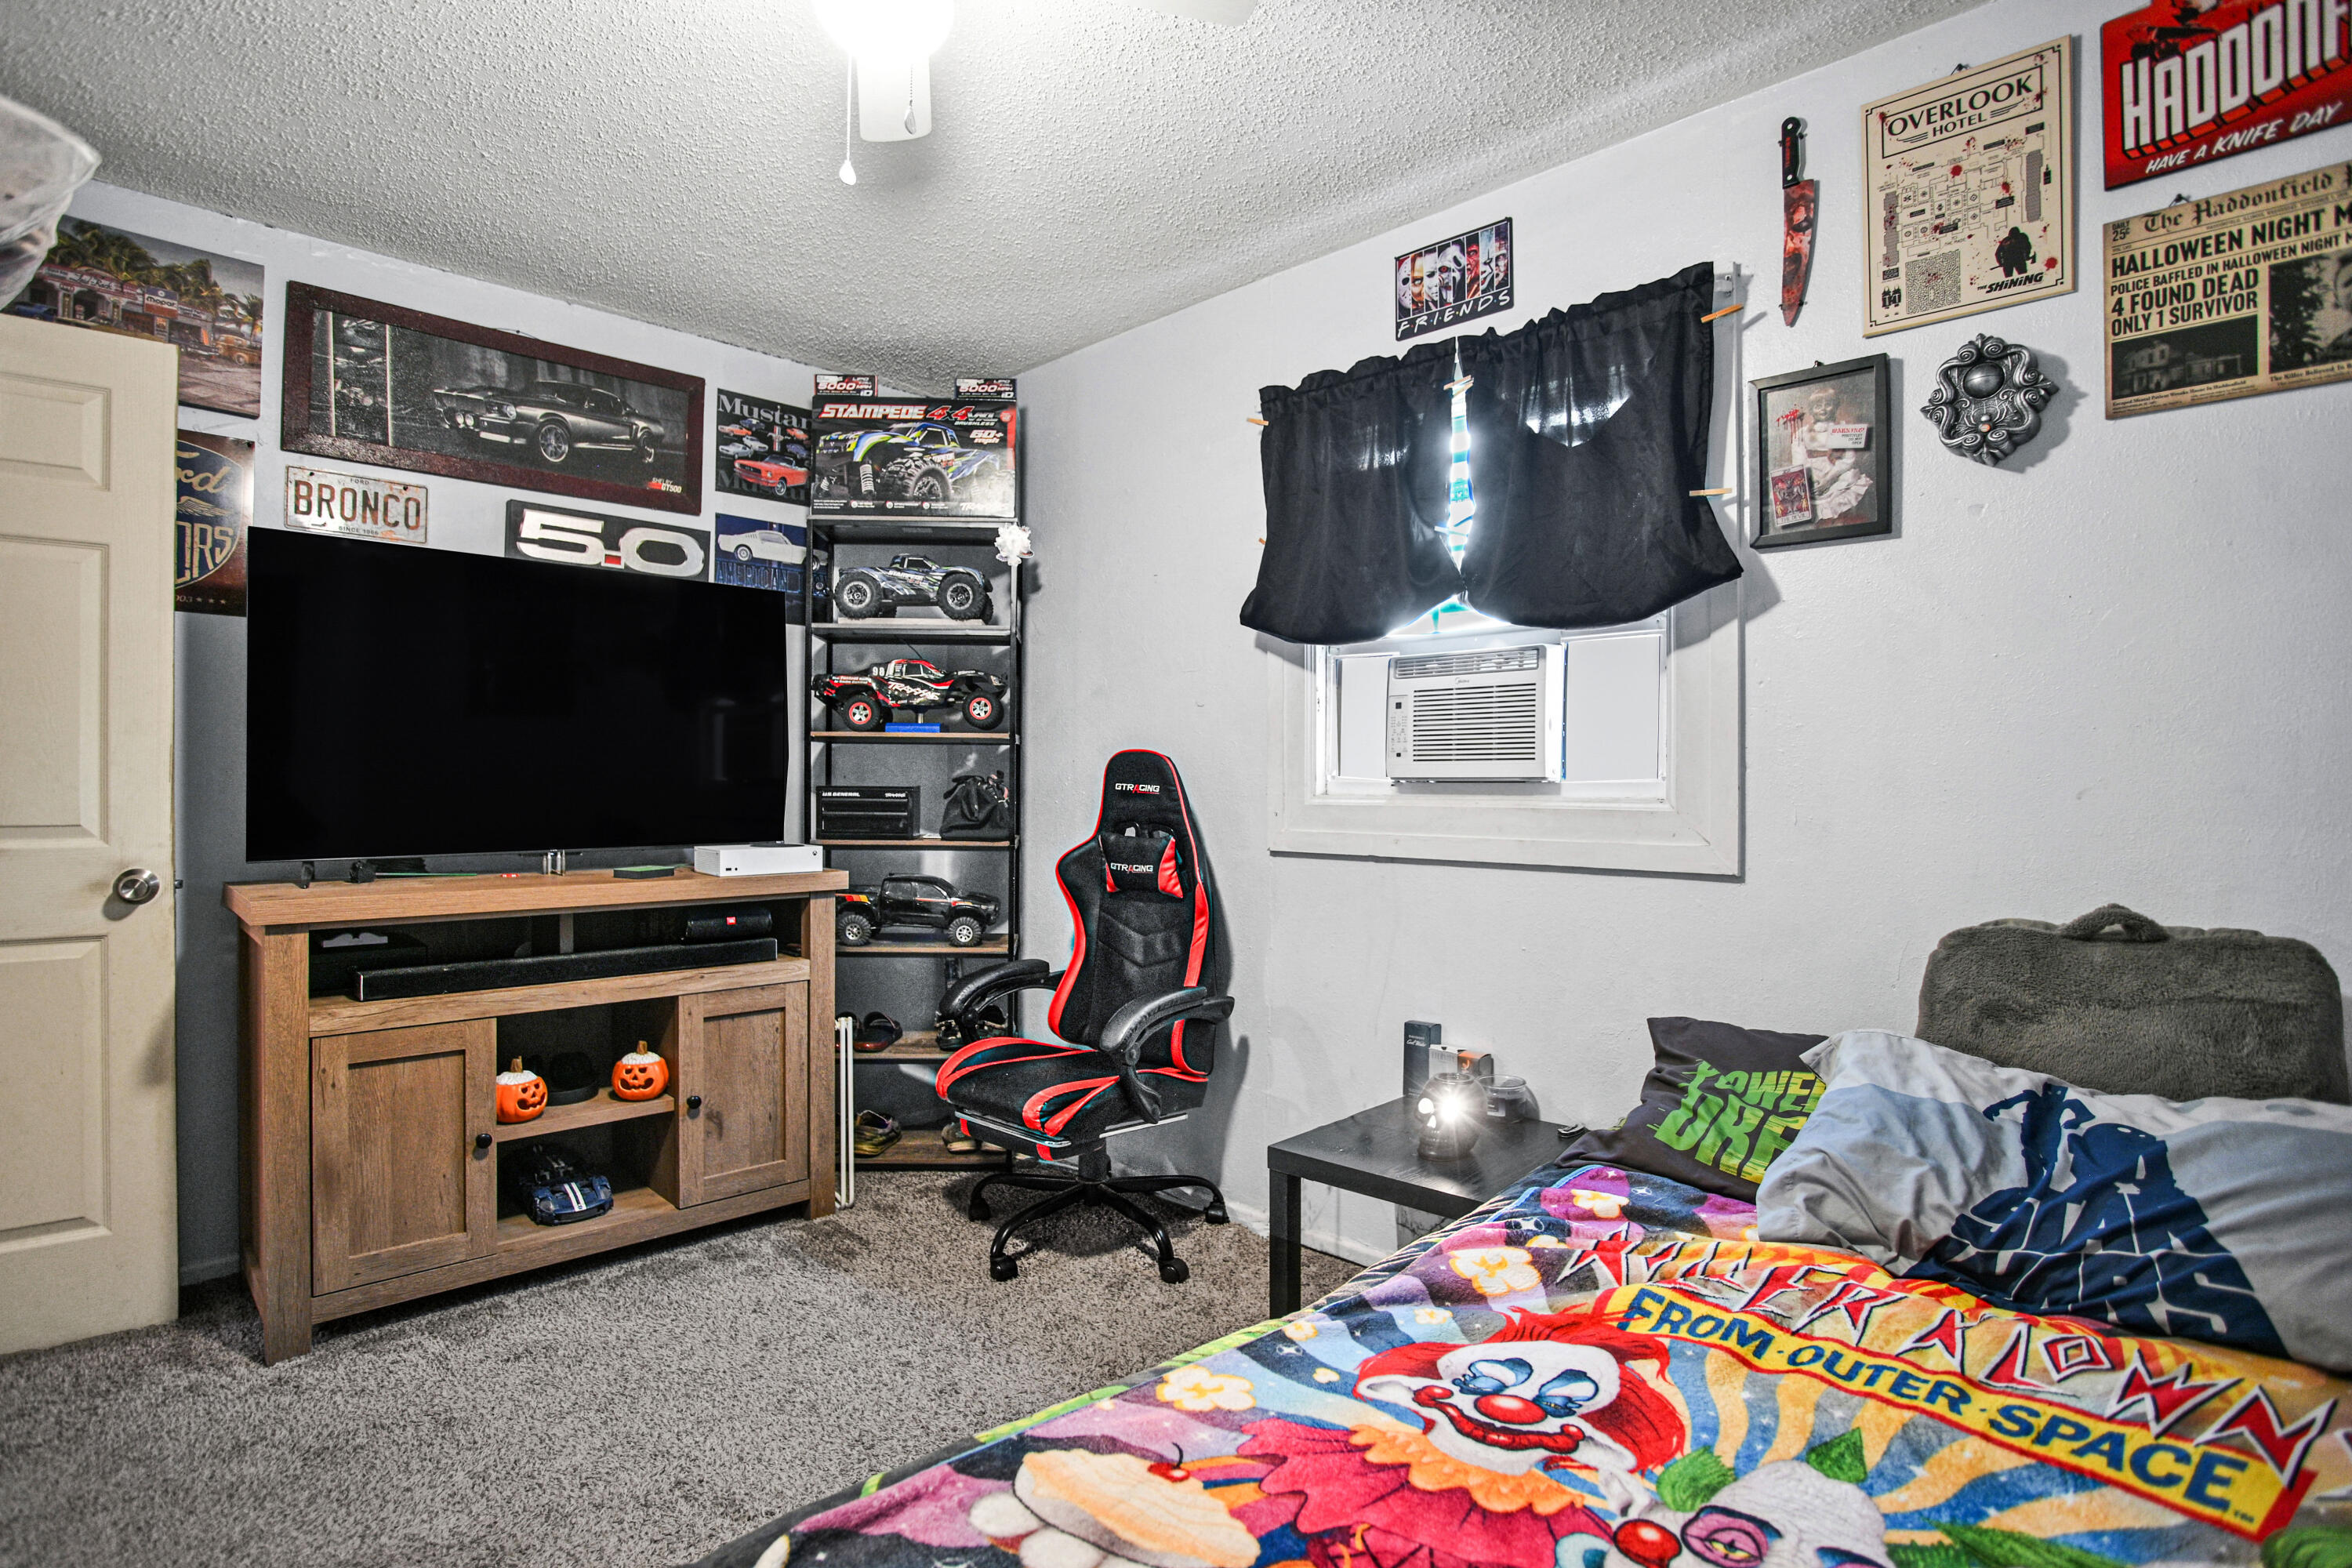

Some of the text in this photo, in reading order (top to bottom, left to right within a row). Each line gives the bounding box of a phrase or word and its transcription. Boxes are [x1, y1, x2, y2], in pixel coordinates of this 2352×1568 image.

[1888, 74, 2032, 136] OVERLOOK
[1933, 111, 1987, 137] HOTEL
[2146, 101, 2343, 174] HAVE A KNIFE DAY
[2112, 220, 2130, 230] DAILY
[2144, 212, 2183, 233] The
[2192, 172, 2332, 226] Haddonfield
[2111, 228, 2243, 278] HALLOWEEN
[2252, 209, 2325, 246] NIGHT
[2111, 277, 2150, 296] POLICE
[2153, 266, 2202, 287] BAFFLED
[2206, 262, 2219, 274] IN
[2223, 243, 2297, 272] HALLOWEEN
[2301, 234, 2341, 254] NIGHT
[2111, 268, 2259, 317] 4 FOUND DEAD
[2111, 291, 2258, 337] ONLY 1 SURVIVOR
[818, 404, 929, 419] STAMPEDE
[969, 429, 1004, 439] 60+
[652, 477, 673, 485] SHELBY
[660, 483, 683, 494] GT500
[294, 480, 421, 530] BRONCO
[516, 509, 706, 577] 5.0
[872, 666, 885, 677] 98
[1115, 783, 1160, 794] GTRACING
[1110, 863, 1154, 873] GTRACING
[1617, 1287, 2249, 1512] FROM OUTER SPACE
